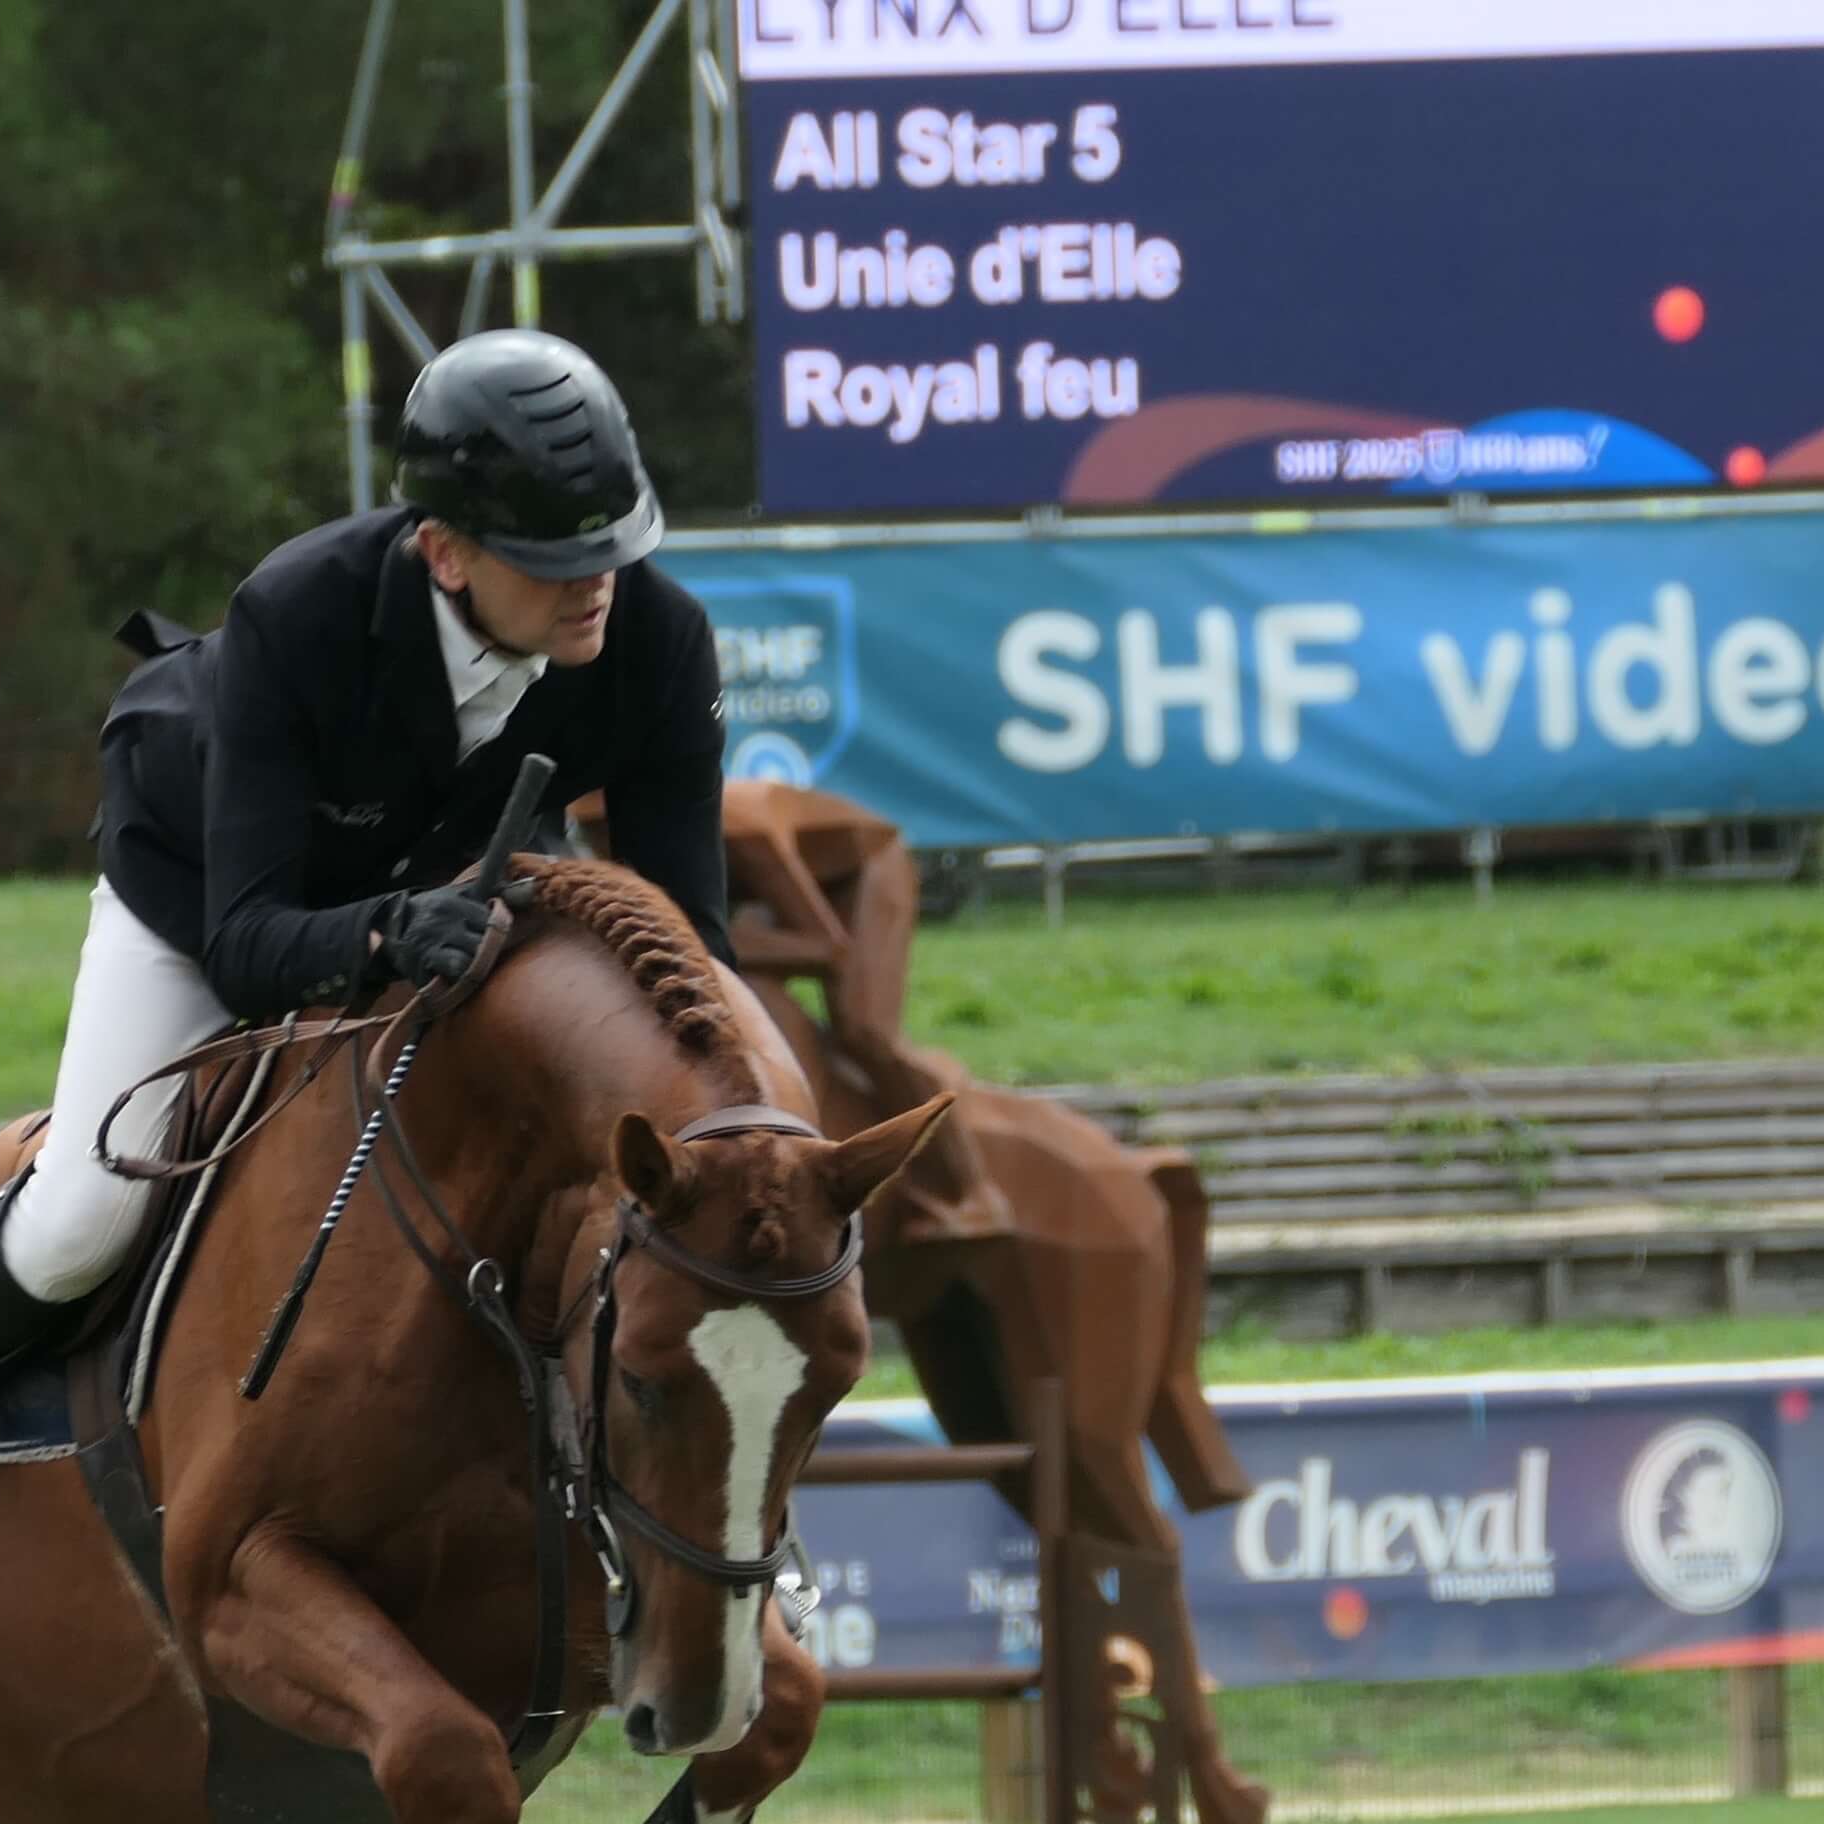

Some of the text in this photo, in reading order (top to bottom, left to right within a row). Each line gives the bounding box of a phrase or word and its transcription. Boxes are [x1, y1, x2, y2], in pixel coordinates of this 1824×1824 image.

[1027, 0, 1335, 35] DELLE
[773, 103, 1122, 191] All Star 5
[779, 221, 1182, 312] Unie d'Elle
[782, 340, 1140, 444] Royal feu
[997, 600, 1364, 772] SHF
[1234, 1448, 1554, 1582] Cheval
